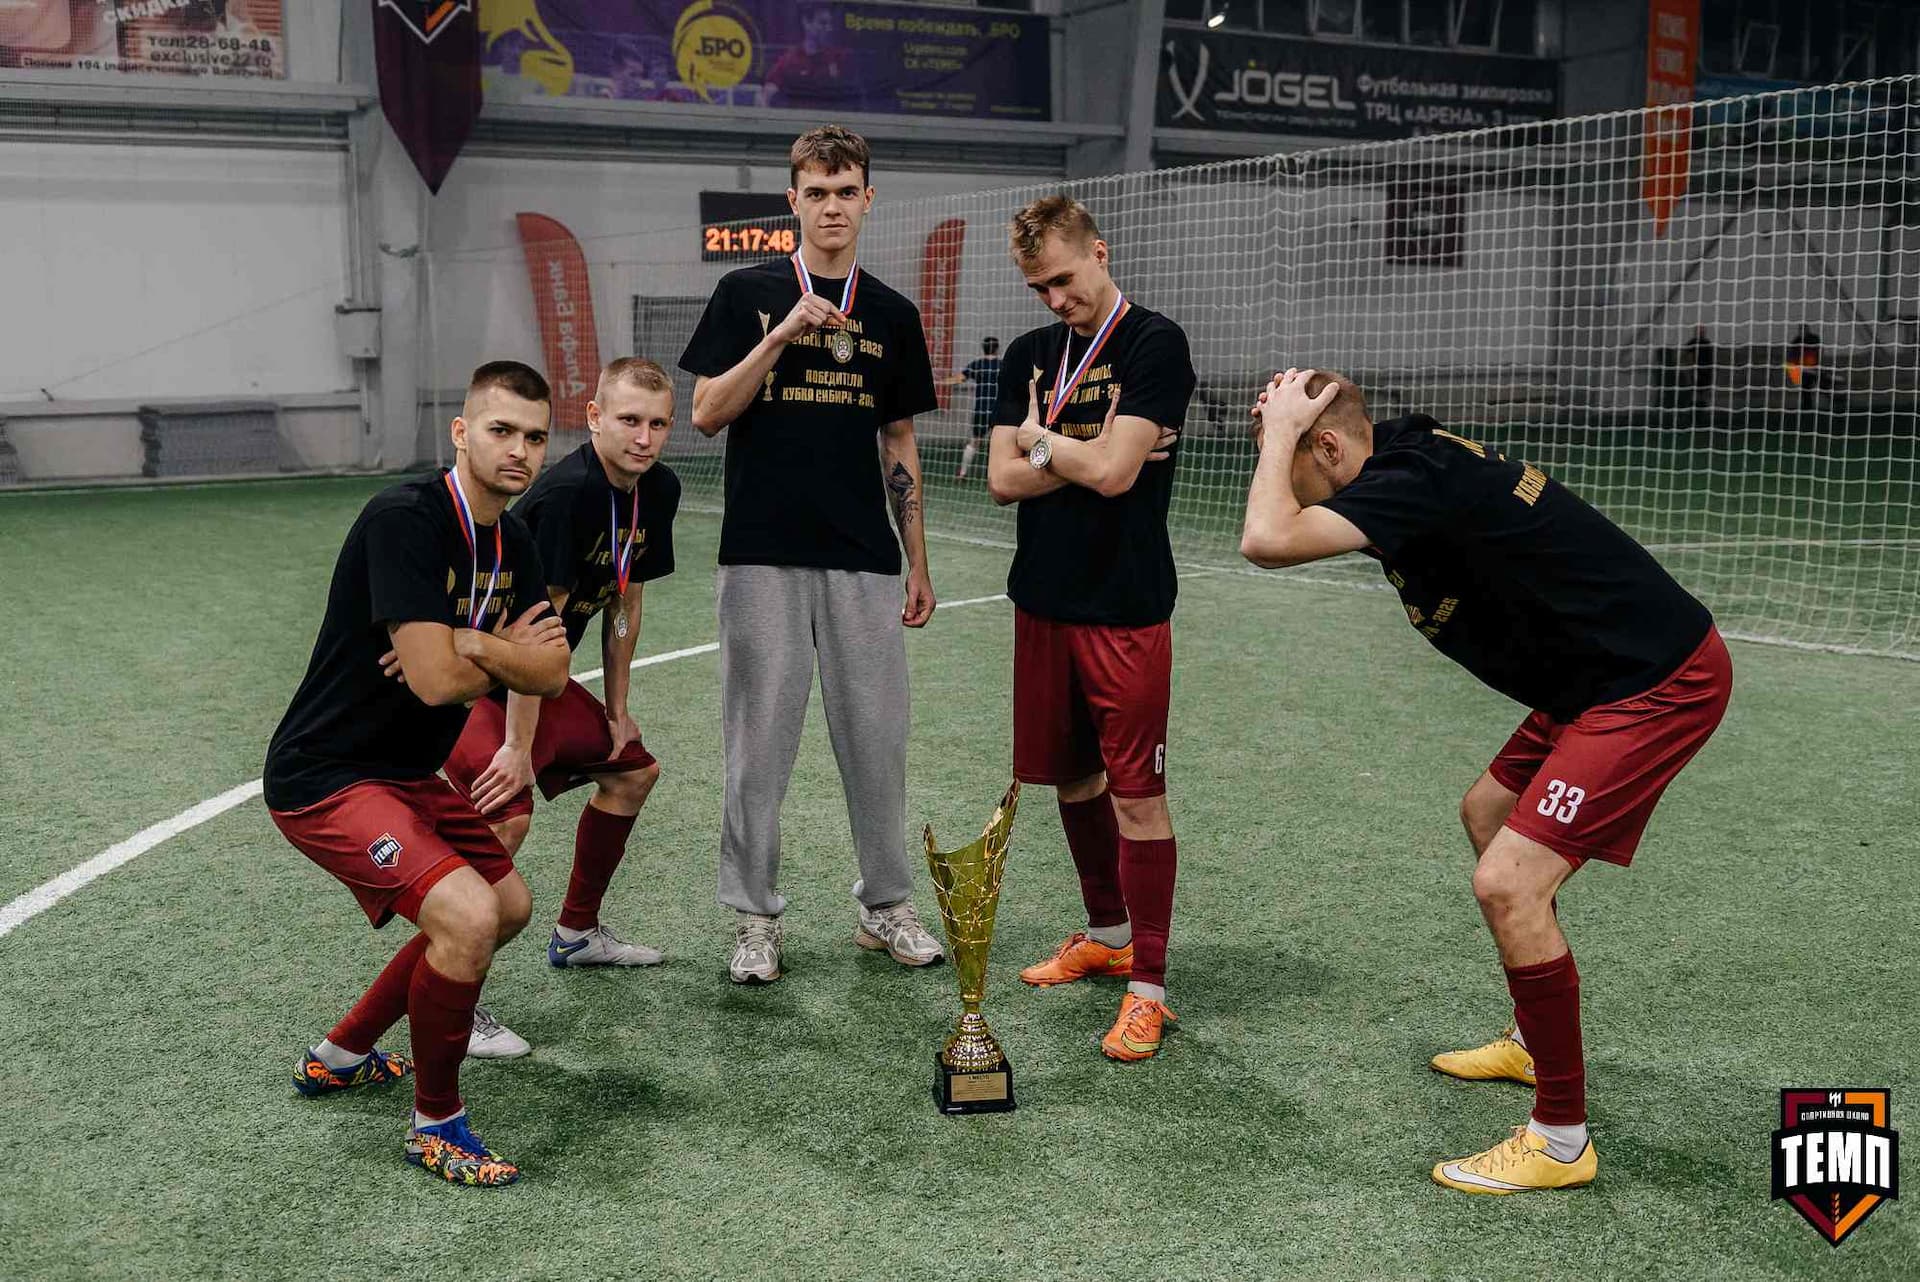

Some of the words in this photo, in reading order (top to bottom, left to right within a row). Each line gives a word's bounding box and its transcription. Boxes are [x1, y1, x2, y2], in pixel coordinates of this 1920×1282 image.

[1365, 102, 1402, 125] ТРЦ
[705, 227, 795, 253] 21:17:48
[1155, 743, 1164, 775] 6
[1537, 779, 1586, 824] 33
